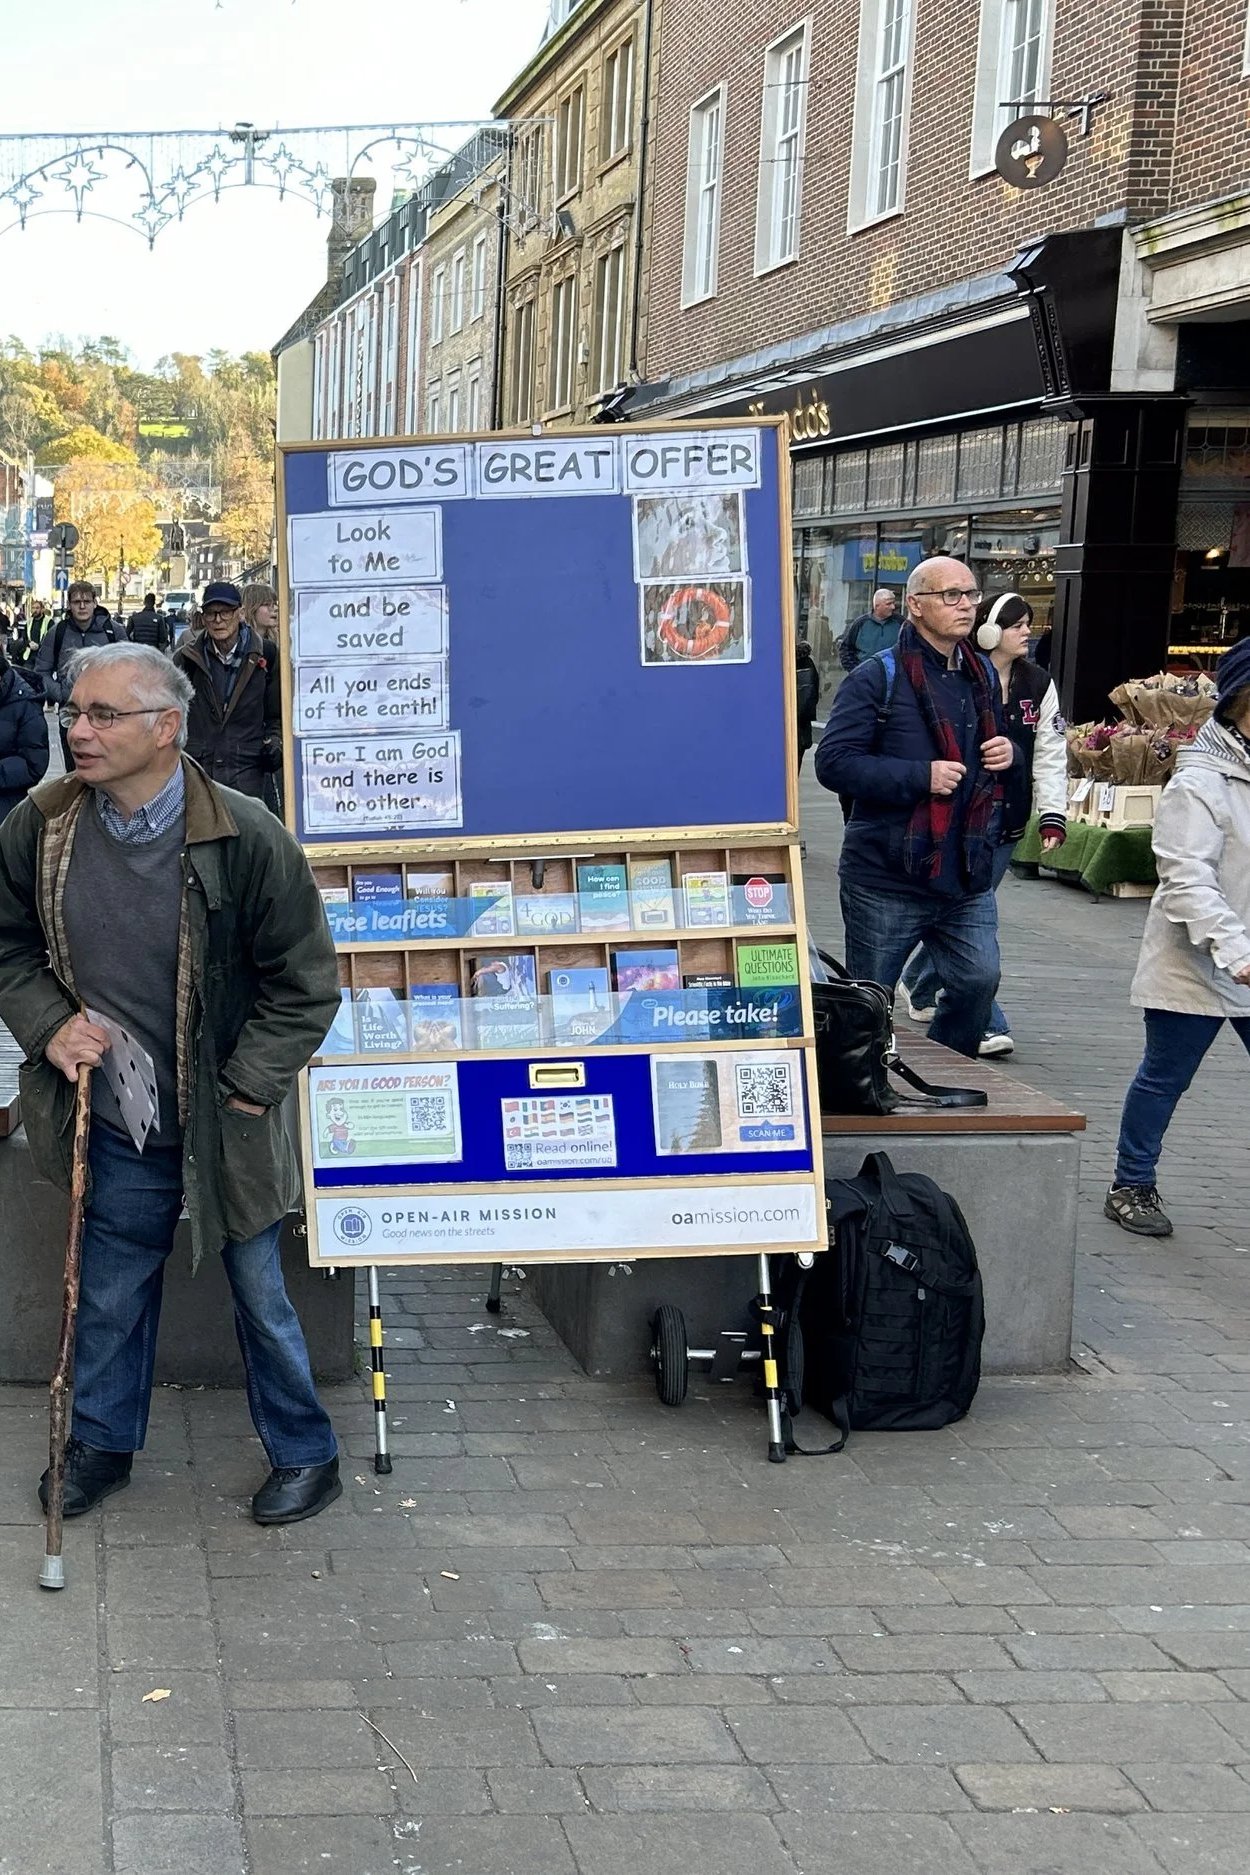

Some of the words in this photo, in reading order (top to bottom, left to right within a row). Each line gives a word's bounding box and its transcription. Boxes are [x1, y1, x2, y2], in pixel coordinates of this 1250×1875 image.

[342, 456, 459, 492] GOD'S
[483, 449, 611, 485] GREAT
[629, 443, 755, 480] OFFER
[336, 519, 391, 544] Look
[327, 554, 353, 575] to
[364, 551, 401, 573] Me
[329, 596, 371, 619] and
[382, 596, 411, 617] be
[336, 625, 404, 649] saved
[309, 676, 335, 694] All
[344, 679, 378, 698] you
[386, 673, 432, 692] ends
[304, 701, 326, 720] of
[335, 700, 368, 718] the
[377, 697, 437, 717] earth!
[312, 747, 346, 766] For
[354, 746, 366, 762] I
[375, 748, 403, 762] am
[412, 740, 449, 760] God
[320, 769, 354, 789] and
[363, 769, 419, 787] there
[428, 767, 444, 784] is
[335, 799, 357, 813] no
[366, 793, 427, 811] other.
[587, 875, 605, 883] How
[604, 882, 620, 890] find
[356, 885, 374, 894] Good
[375, 885, 401, 895] Enough
[415, 887, 431, 895] Will
[431, 887, 447, 895] You
[592, 890, 621, 899] peace?
[747, 887, 770, 899] STOP
[325, 911, 368, 933] Free
[371, 909, 448, 932] leaflets
[750, 948, 793, 962] ULTIMATE
[744, 960, 794, 975] QUESTIONS
[493, 1001, 535, 1011] Suffering?
[361, 1015, 371, 1023] Is
[653, 1005, 721, 1027] Please
[724, 1002, 779, 1024] take!
[362, 1023, 384, 1031] Life
[570, 1025, 596, 1035] JOHN
[363, 1031, 397, 1040] Worth
[364, 1041, 403, 1050] Living?
[316, 1079, 336, 1092] ARE
[338, 1079, 360, 1091] YOU
[361, 1078, 369, 1090] A
[370, 1077, 402, 1090] GOOD
[403, 1074, 452, 1089] PERSON?
[668, 1081, 688, 1090] HOLY
[748, 1130, 771, 1138] SCAN
[772, 1129, 786, 1138] ME
[535, 1142, 567, 1154] Read
[570, 1140, 613, 1154] online!
[381, 1210, 471, 1224] OPEN-AIR
[479, 1207, 558, 1222] MISSION
[671, 1206, 800, 1225] oamission.com
[382, 1228, 408, 1239] Good
[408, 1229, 433, 1238] news
[434, 1229, 446, 1238] on
[447, 1227, 463, 1237] the
[464, 1226, 495, 1237] streets
